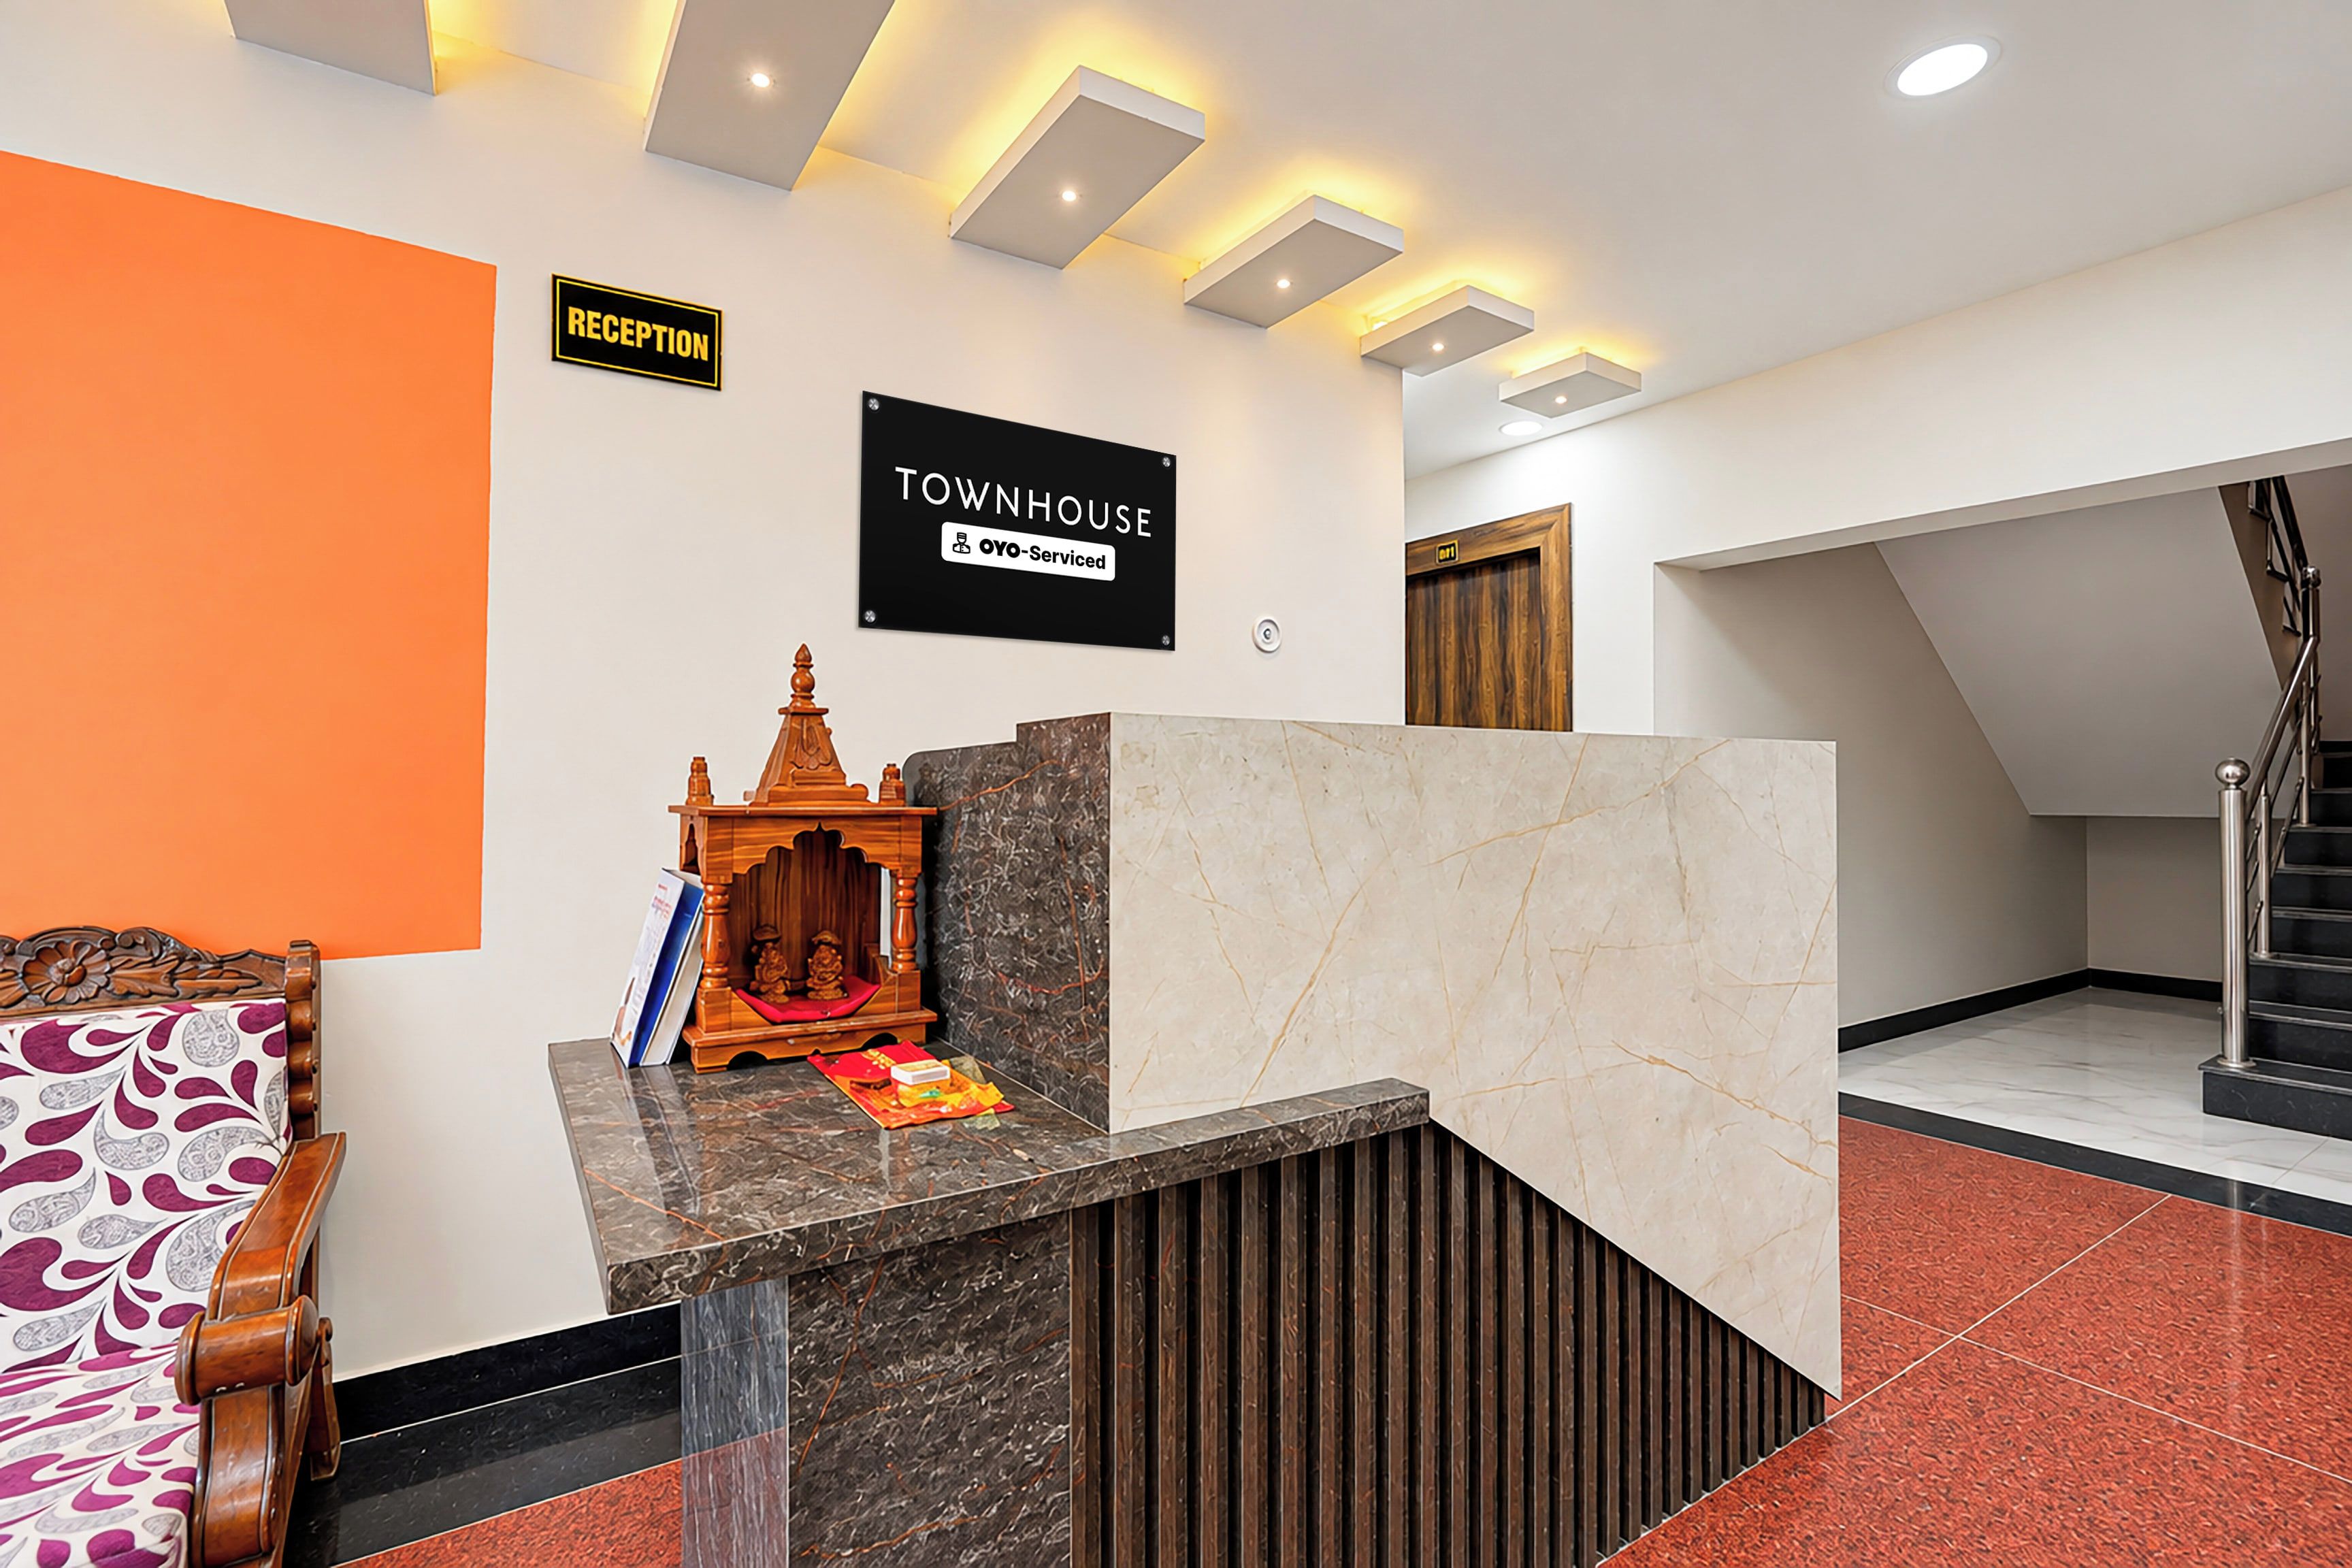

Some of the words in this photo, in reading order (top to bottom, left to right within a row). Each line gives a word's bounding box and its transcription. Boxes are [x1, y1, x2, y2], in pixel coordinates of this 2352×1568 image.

[568, 306, 708, 361] RECEPTION
[895, 466, 1152, 538] TOWNHOUSE
[979, 538, 1106, 570] OYO-Serviced
